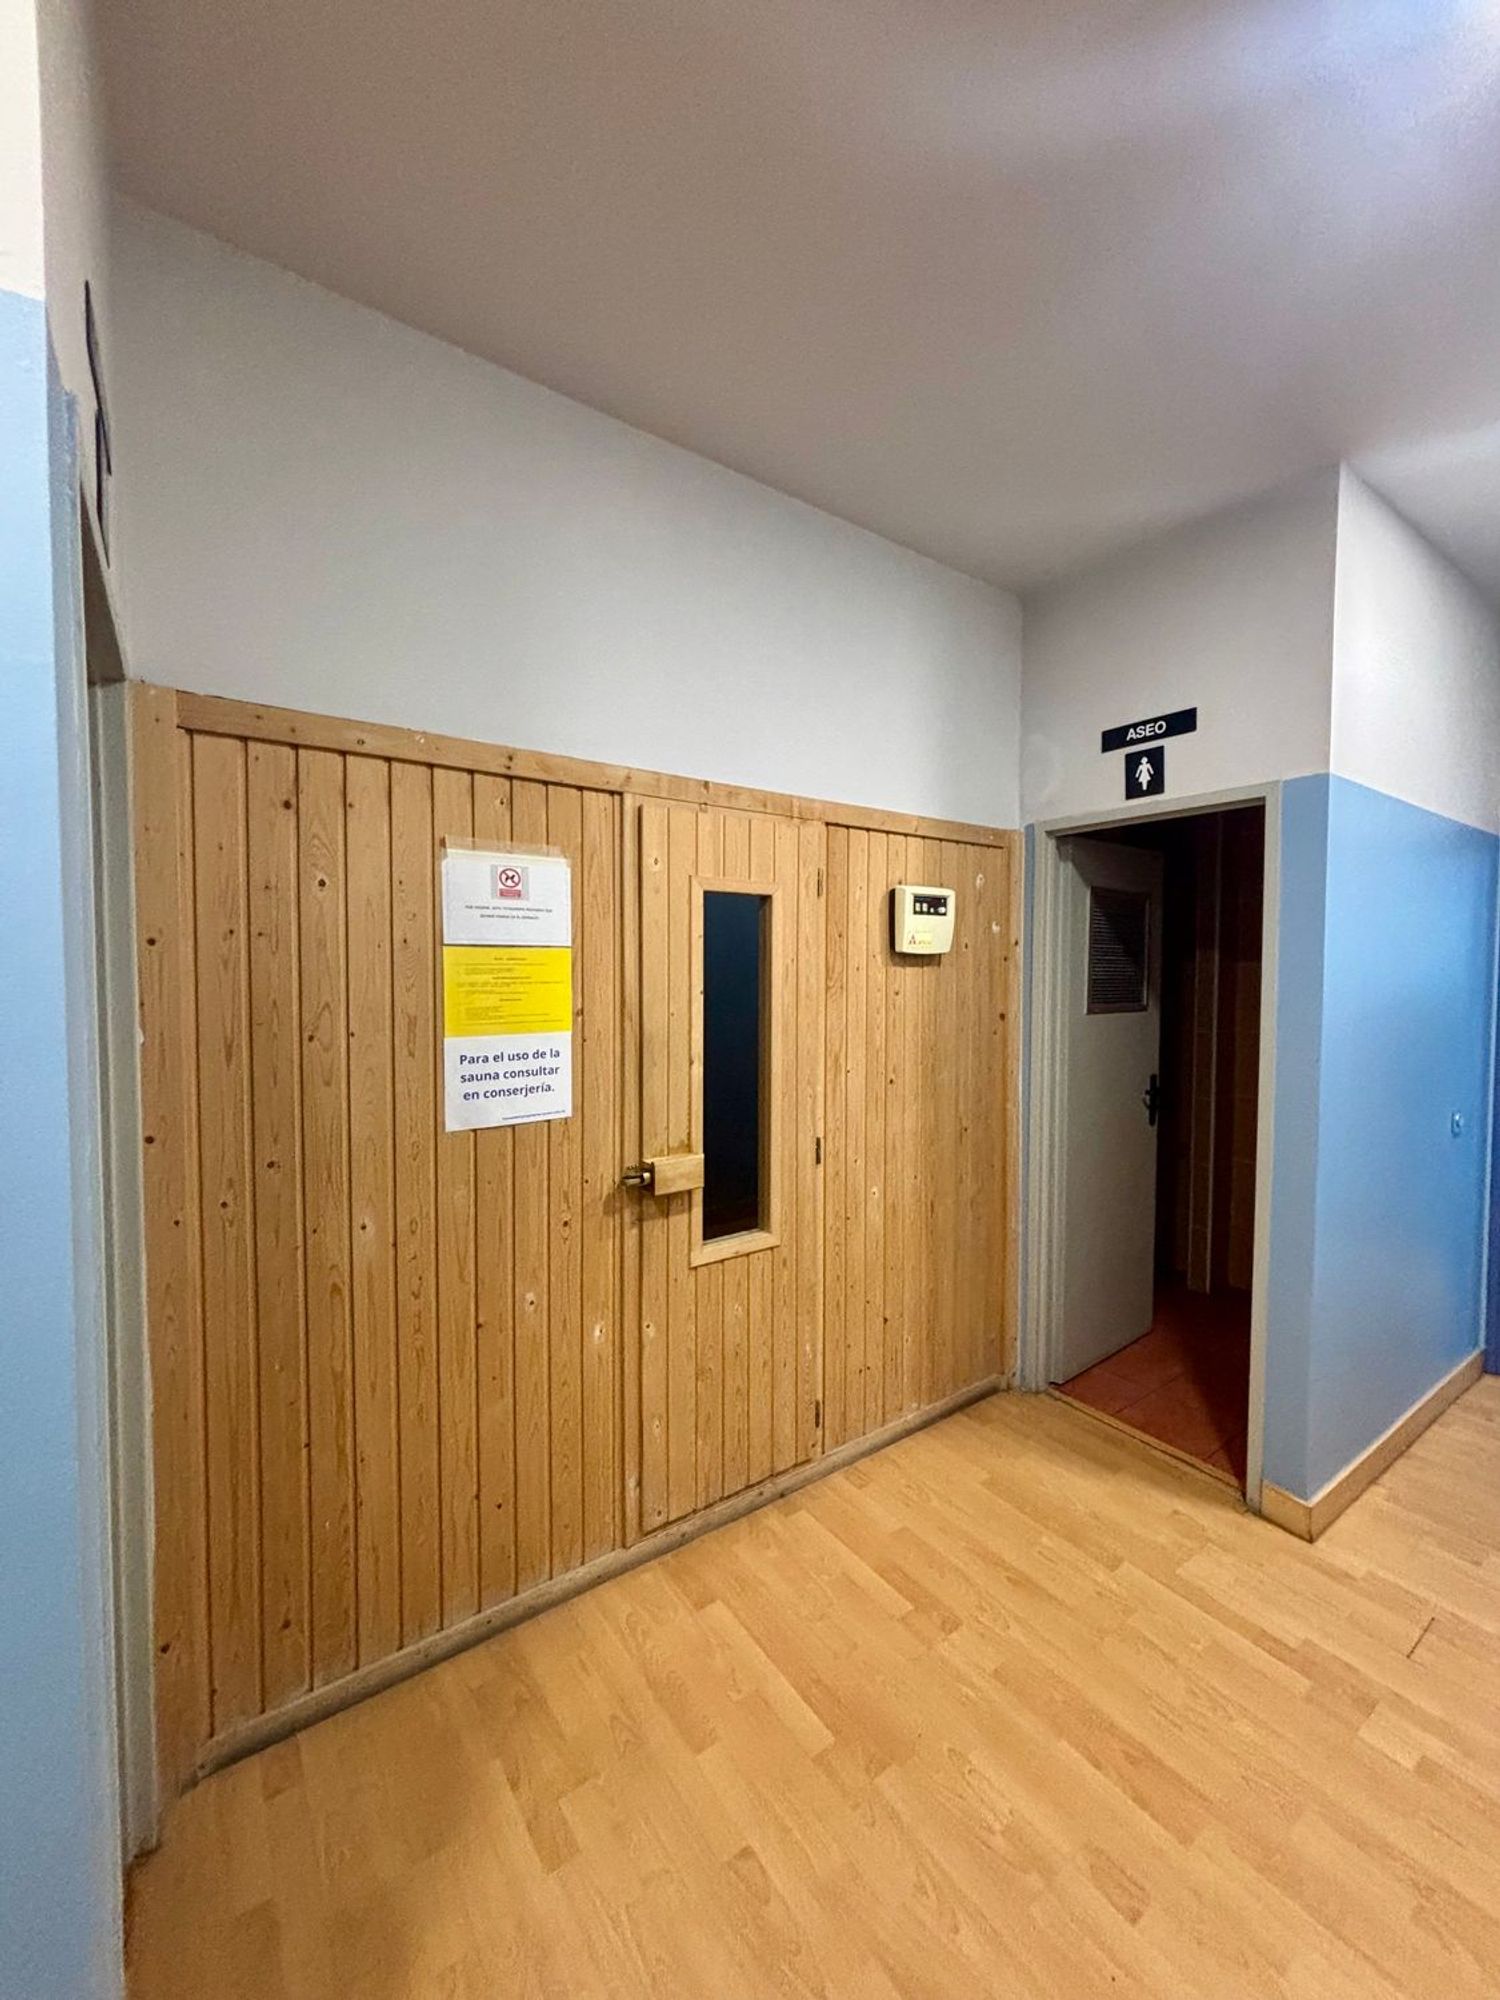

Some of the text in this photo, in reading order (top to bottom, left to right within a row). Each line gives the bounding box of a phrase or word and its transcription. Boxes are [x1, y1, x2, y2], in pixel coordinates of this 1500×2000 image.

[1126, 721, 1167, 741] ASEO
[460, 1048, 560, 1065] Para el uso de la
[460, 1066, 560, 1083] sauna consultar
[463, 1083, 555, 1101] en conserjería.
